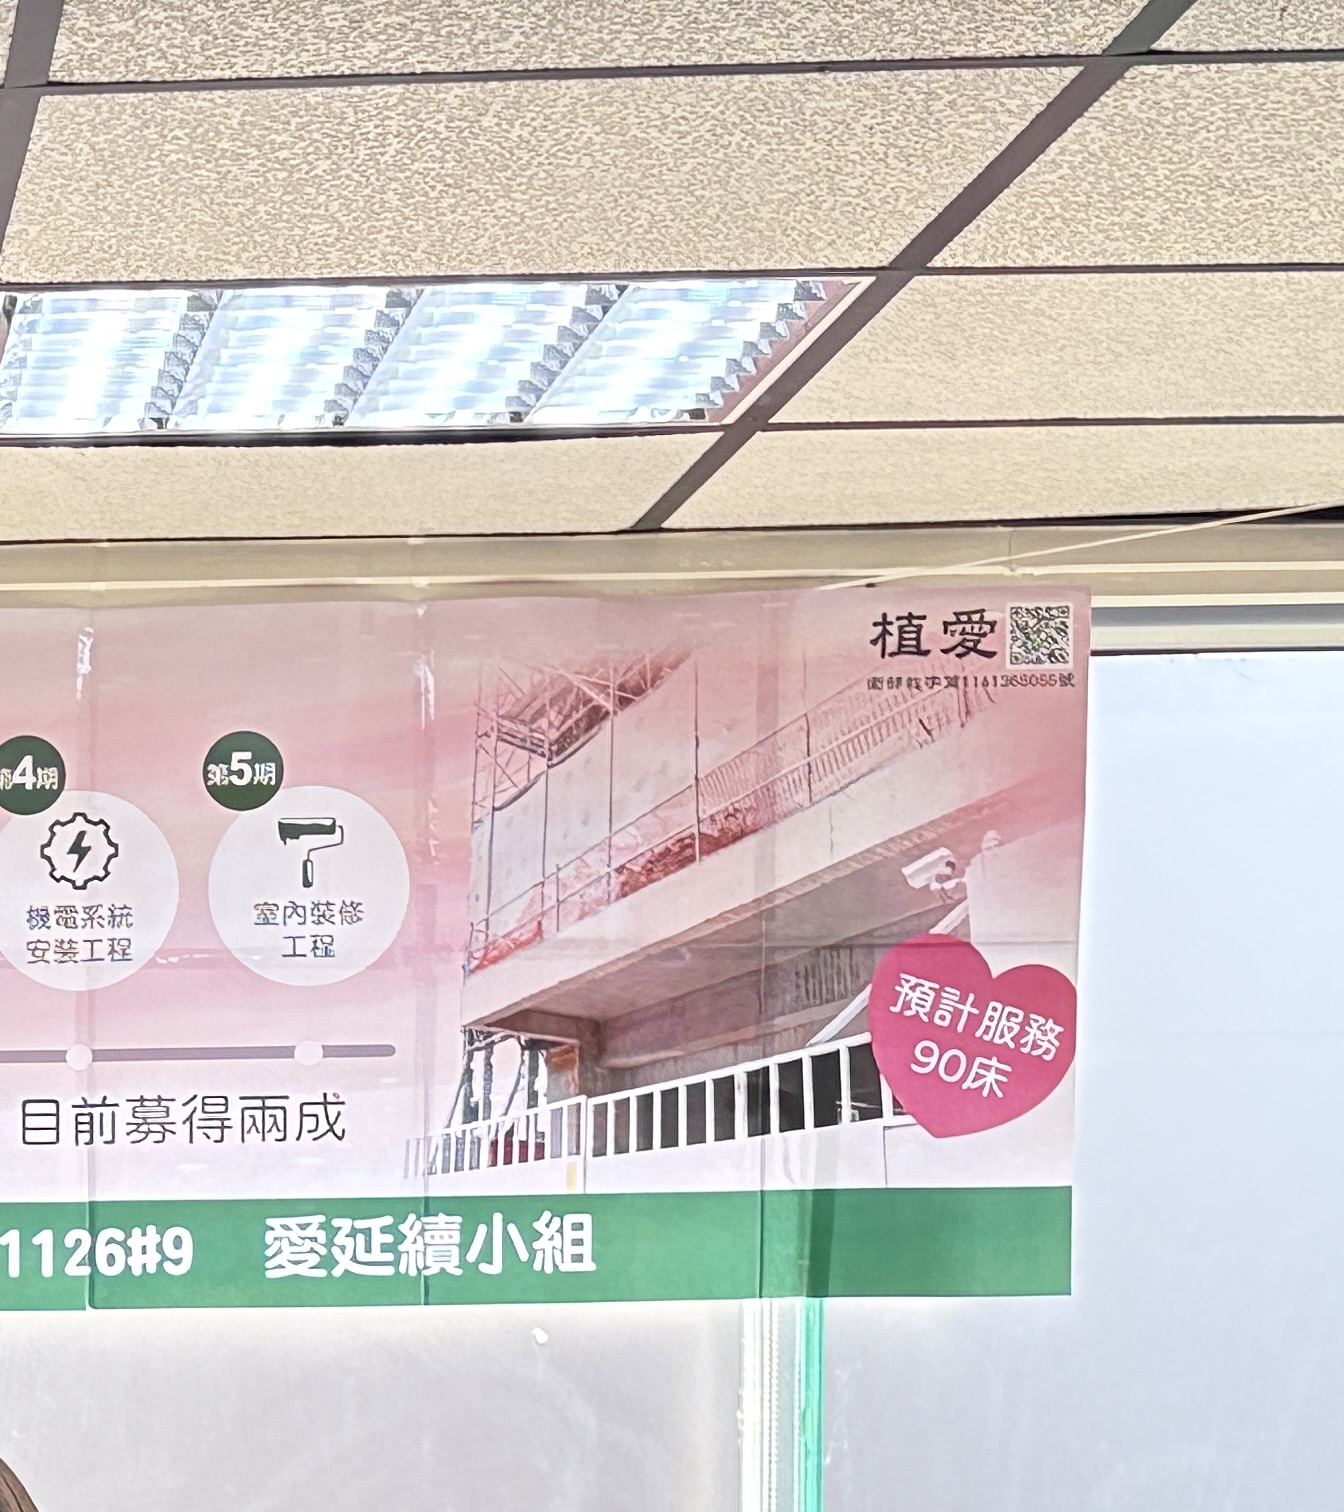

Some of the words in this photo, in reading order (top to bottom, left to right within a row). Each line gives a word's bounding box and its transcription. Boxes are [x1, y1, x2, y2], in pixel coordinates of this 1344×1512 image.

[870, 607, 998, 660] 植愛
[207, 751, 276, 786] 第5期
[25, 903, 134, 930] 機電系統
[253, 899, 365, 926] 室內裝修
[26, 937, 134, 965] 安裝工程
[281, 934, 336, 958] 工程
[889, 972, 1063, 1063] 預計服務
[910, 1039, 1013, 1100] 90床
[263, 1211, 598, 1280] 愛延續小組
